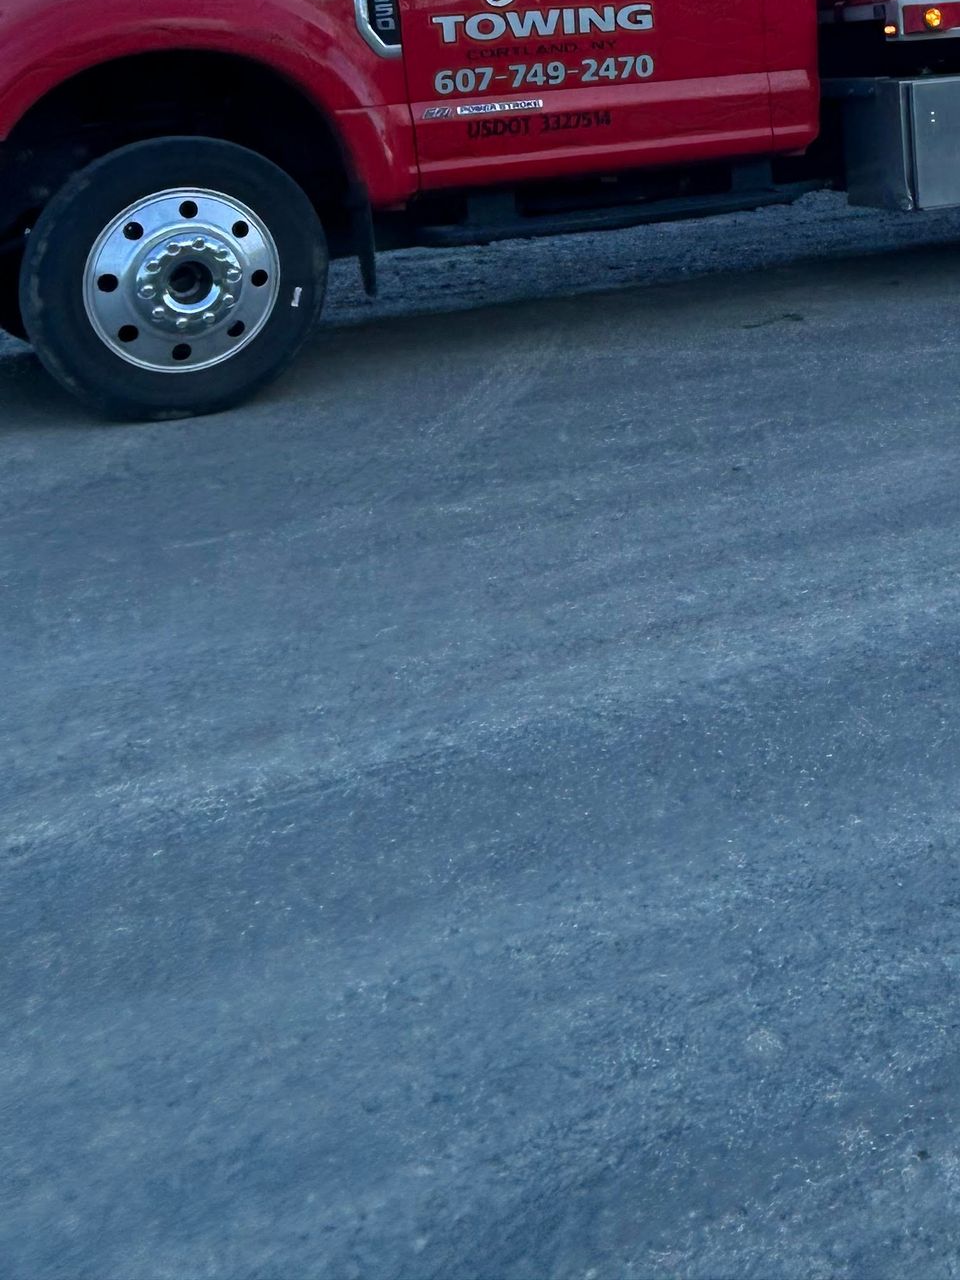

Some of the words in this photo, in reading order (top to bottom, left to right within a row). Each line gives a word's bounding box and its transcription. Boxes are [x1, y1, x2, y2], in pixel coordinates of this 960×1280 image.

[431, 3, 654, 45] TOWING
[591, 40, 617, 51] NY
[433, 54, 655, 95] 607-749-2470
[467, 115, 530, 139] USDOT
